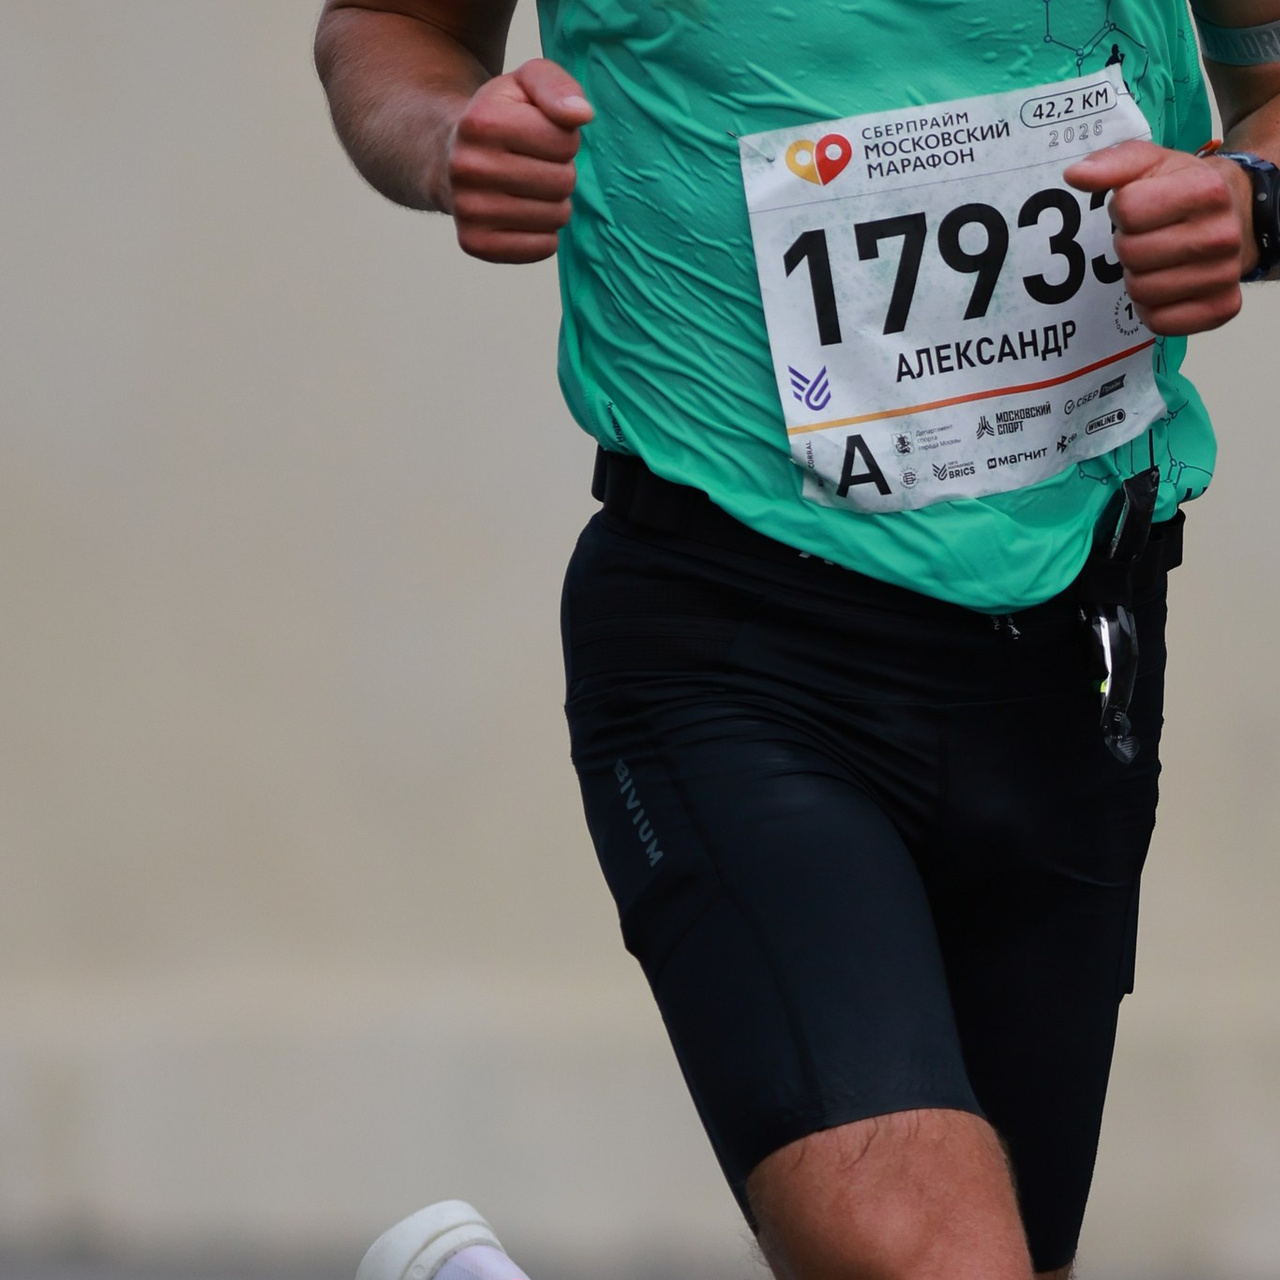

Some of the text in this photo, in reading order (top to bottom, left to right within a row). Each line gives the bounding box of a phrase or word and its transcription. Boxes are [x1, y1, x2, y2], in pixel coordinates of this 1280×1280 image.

[1032, 97, 1074, 121] 42,2
[861, 111, 969, 141] СБЕРПРАЙМ
[1048, 119, 1104, 147] 2026
[863, 118, 1010, 160] МОСКОВСКИЙ
[867, 148, 975, 179] МАРАФОН
[896, 320, 1077, 384] АЛЕКСАНДР
[1076, 389, 1099, 408] СБЕР
[995, 401, 1052, 424] МОСКОВСКИЙ
[1087, 413, 1116, 432] WINLINE
[996, 420, 1024, 436] СПОРТ
[805, 440, 815, 469] CORRAL
[998, 447, 1048, 467] магнит
[949, 466, 976, 479] BRICS
